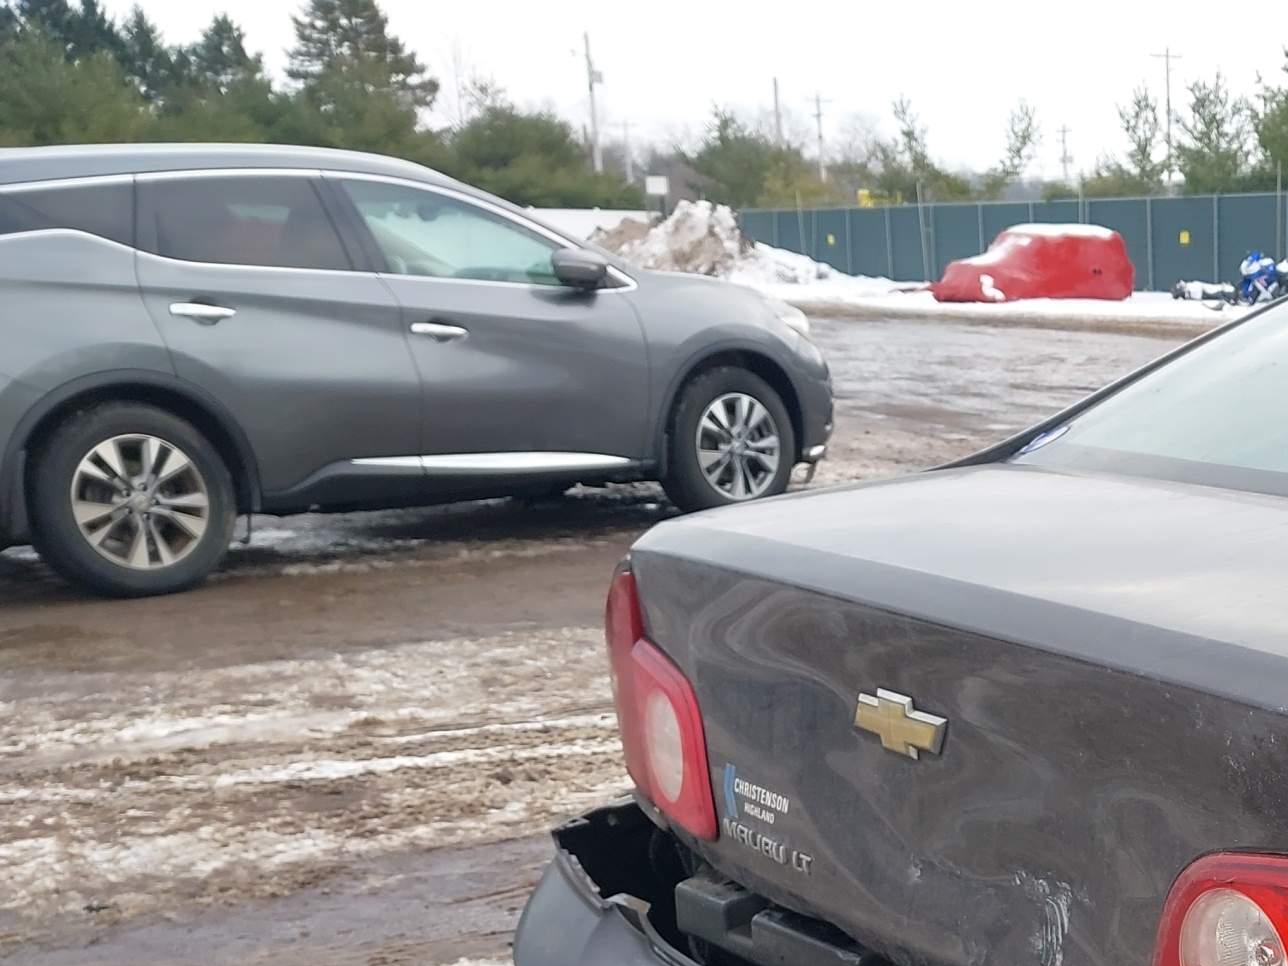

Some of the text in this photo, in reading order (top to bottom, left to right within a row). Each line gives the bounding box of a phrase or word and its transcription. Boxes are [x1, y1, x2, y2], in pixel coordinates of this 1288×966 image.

[734, 778, 789, 813] CHRISTENSON
[744, 802, 775, 824] HIGHLAND
[792, 850, 812, 873] LT
